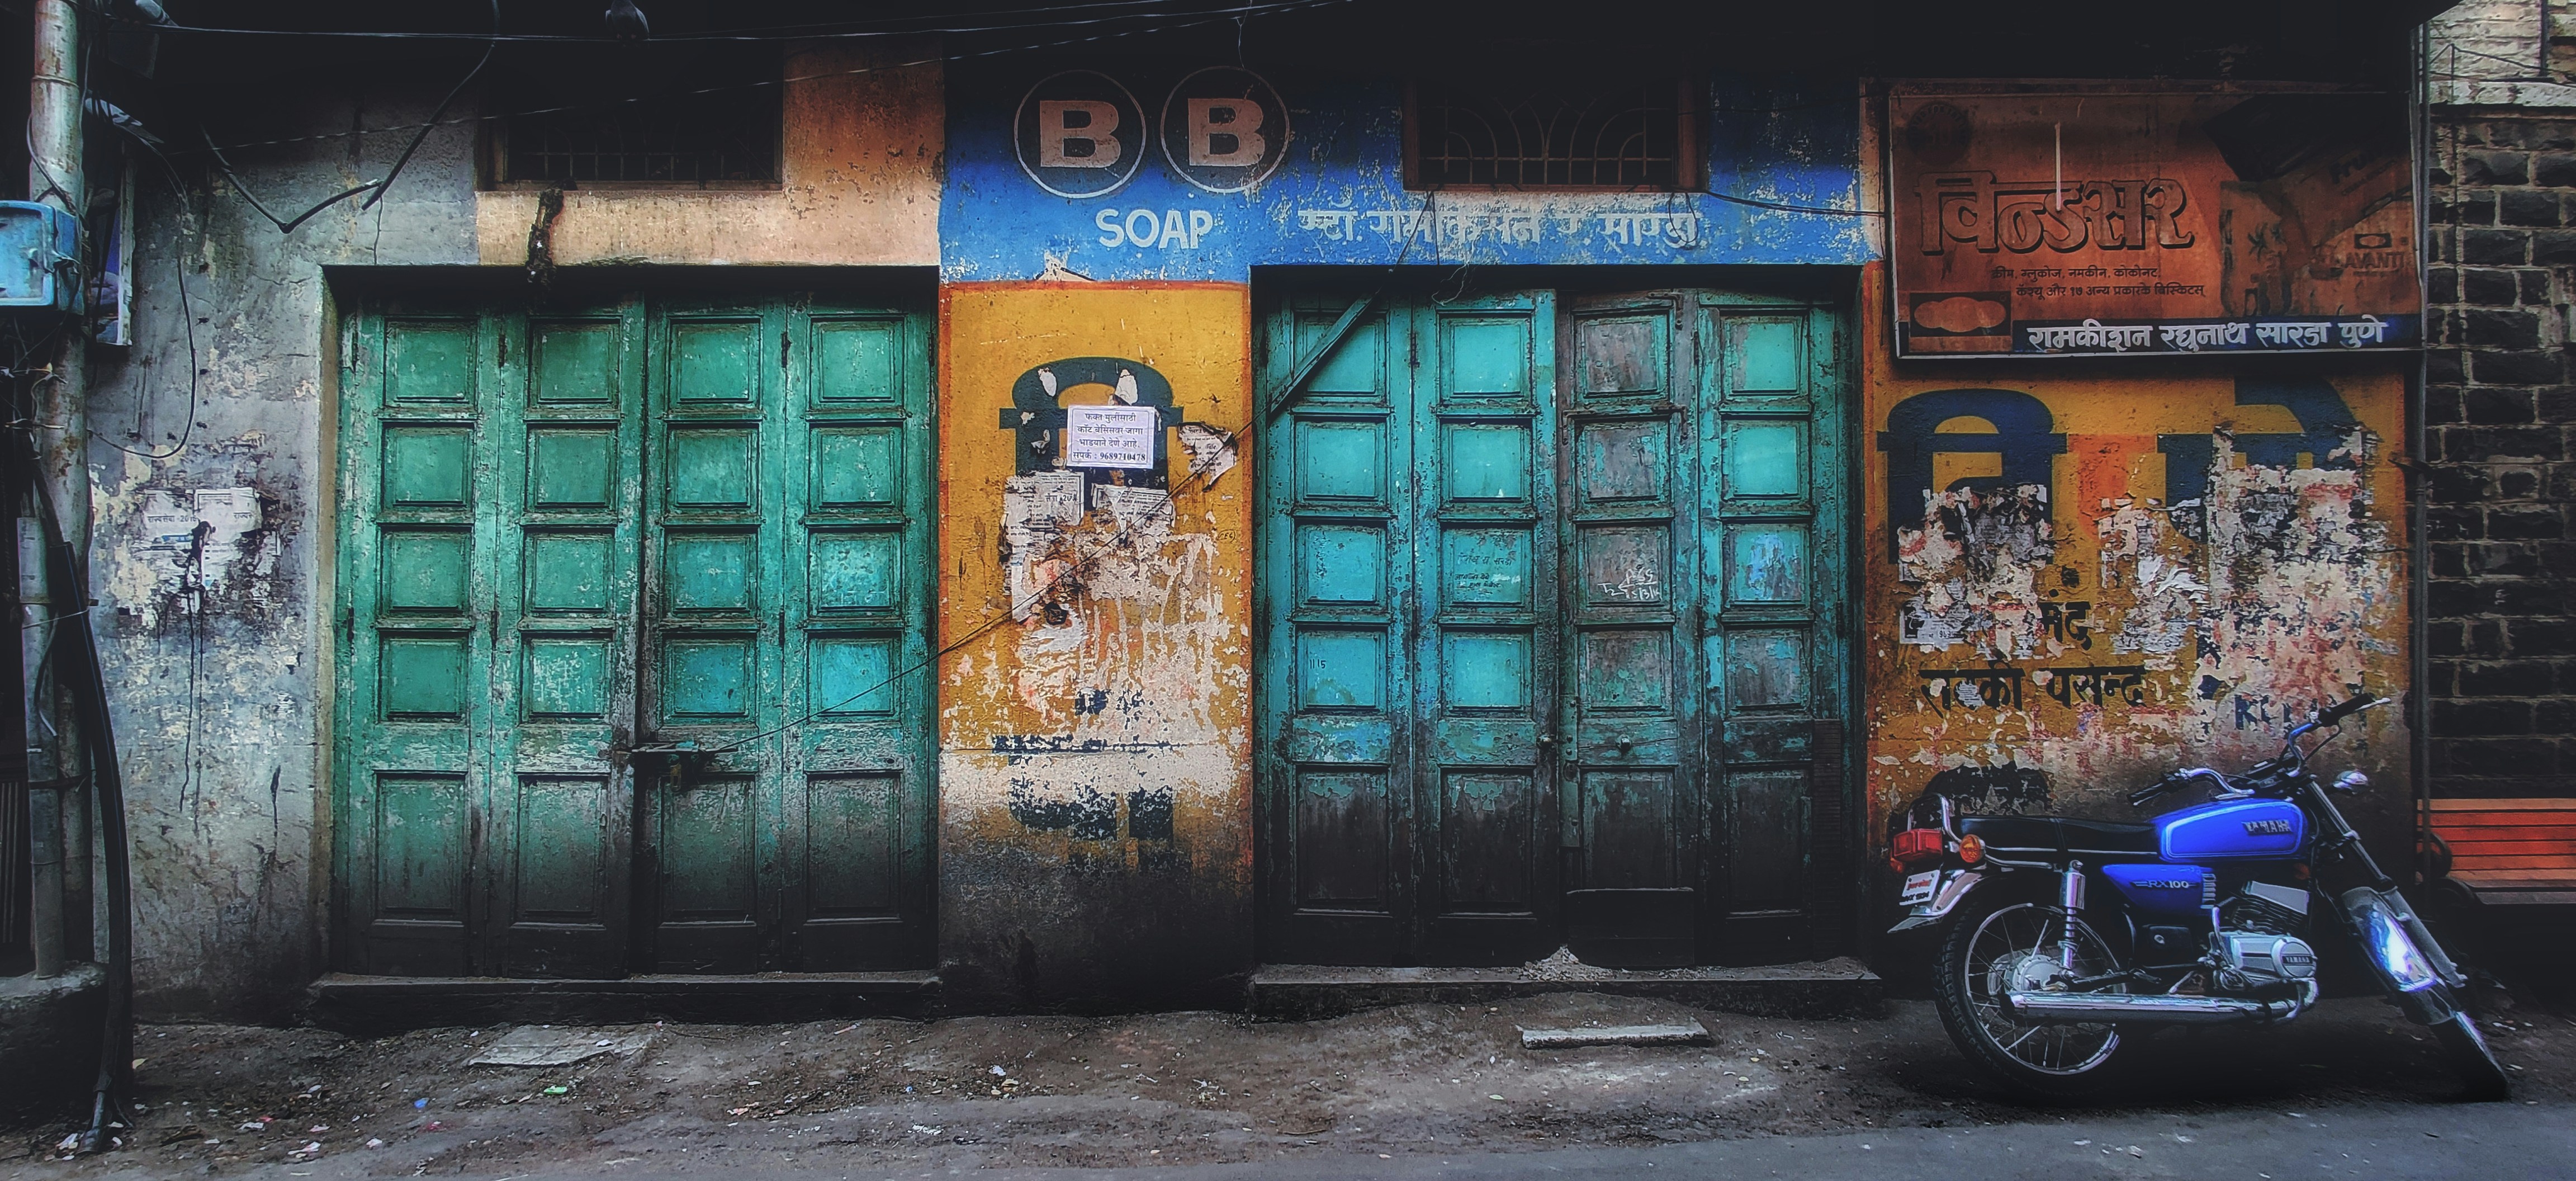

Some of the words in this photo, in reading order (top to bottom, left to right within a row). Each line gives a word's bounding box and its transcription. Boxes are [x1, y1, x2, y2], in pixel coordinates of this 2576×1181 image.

[1040, 100, 1121, 168] B
[1187, 98, 1266, 167] B
[1095, 209, 1214, 249] SOAP
[2020, 266, 2064, 282] ग्लुकोज,
[2068, 265, 2110, 279] नमकीन,
[2113, 265, 2161, 279] कोकोनट,
[2046, 284, 2066, 296] और
[2086, 285, 2109, 296] अन्य
[2160, 321, 2248, 352] रघुनाथ
[2255, 322, 2331, 349] सारडा
[2338, 313, 2388, 349] पुणे
[1085, 413, 1102, 421] फक्त
[1105, 412, 1137, 424] मुलींसाठी
[1077, 424, 1093, 433] कॉट
[1094, 424, 1124, 435] बेसिसवर
[1125, 427, 1144, 435] जागा
[1107, 437, 1120, 448] देणे
[1122, 438, 1140, 448] आहे.
[1073, 449, 1092, 460] संपर्क
[1100, 452, 1146, 461] 9689710478
[2147, 880, 2190, 889] RX100
